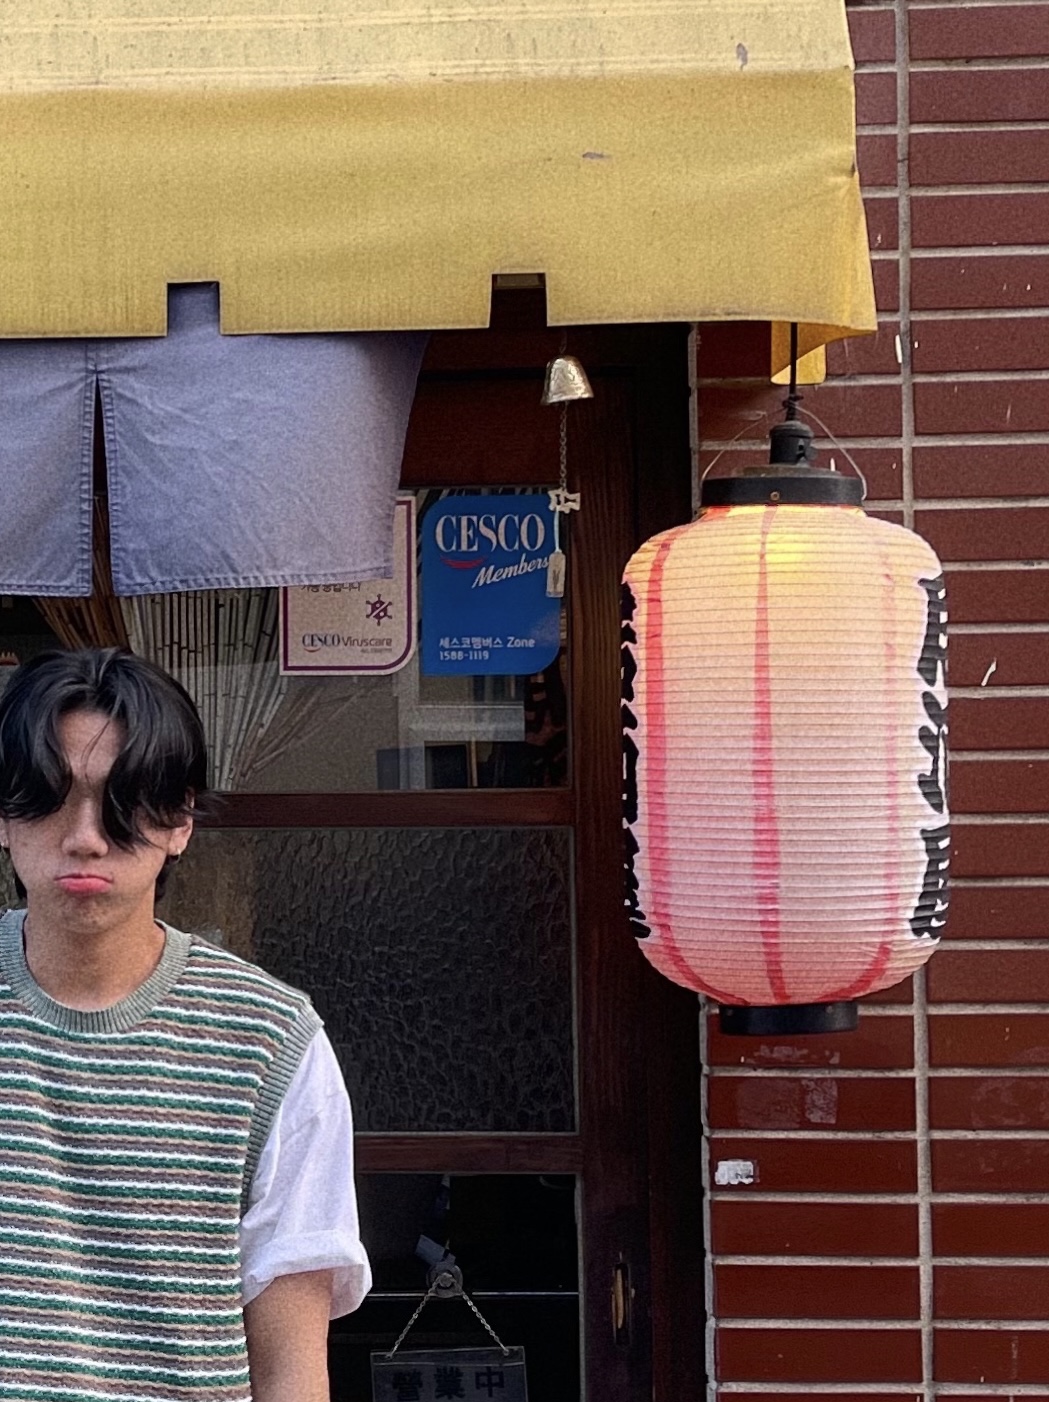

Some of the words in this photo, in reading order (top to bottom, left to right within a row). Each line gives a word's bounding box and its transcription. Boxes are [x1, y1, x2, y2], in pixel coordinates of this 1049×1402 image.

[435, 513, 546, 552] CESCO
[471, 552, 549, 589] Members
[302, 633, 340, 648] CESCO
[341, 636, 393, 647] Viruscare
[439, 636, 504, 649] 세스코멤버스
[506, 636, 536, 648] Zone
[439, 650, 490, 661] 1588-1119
